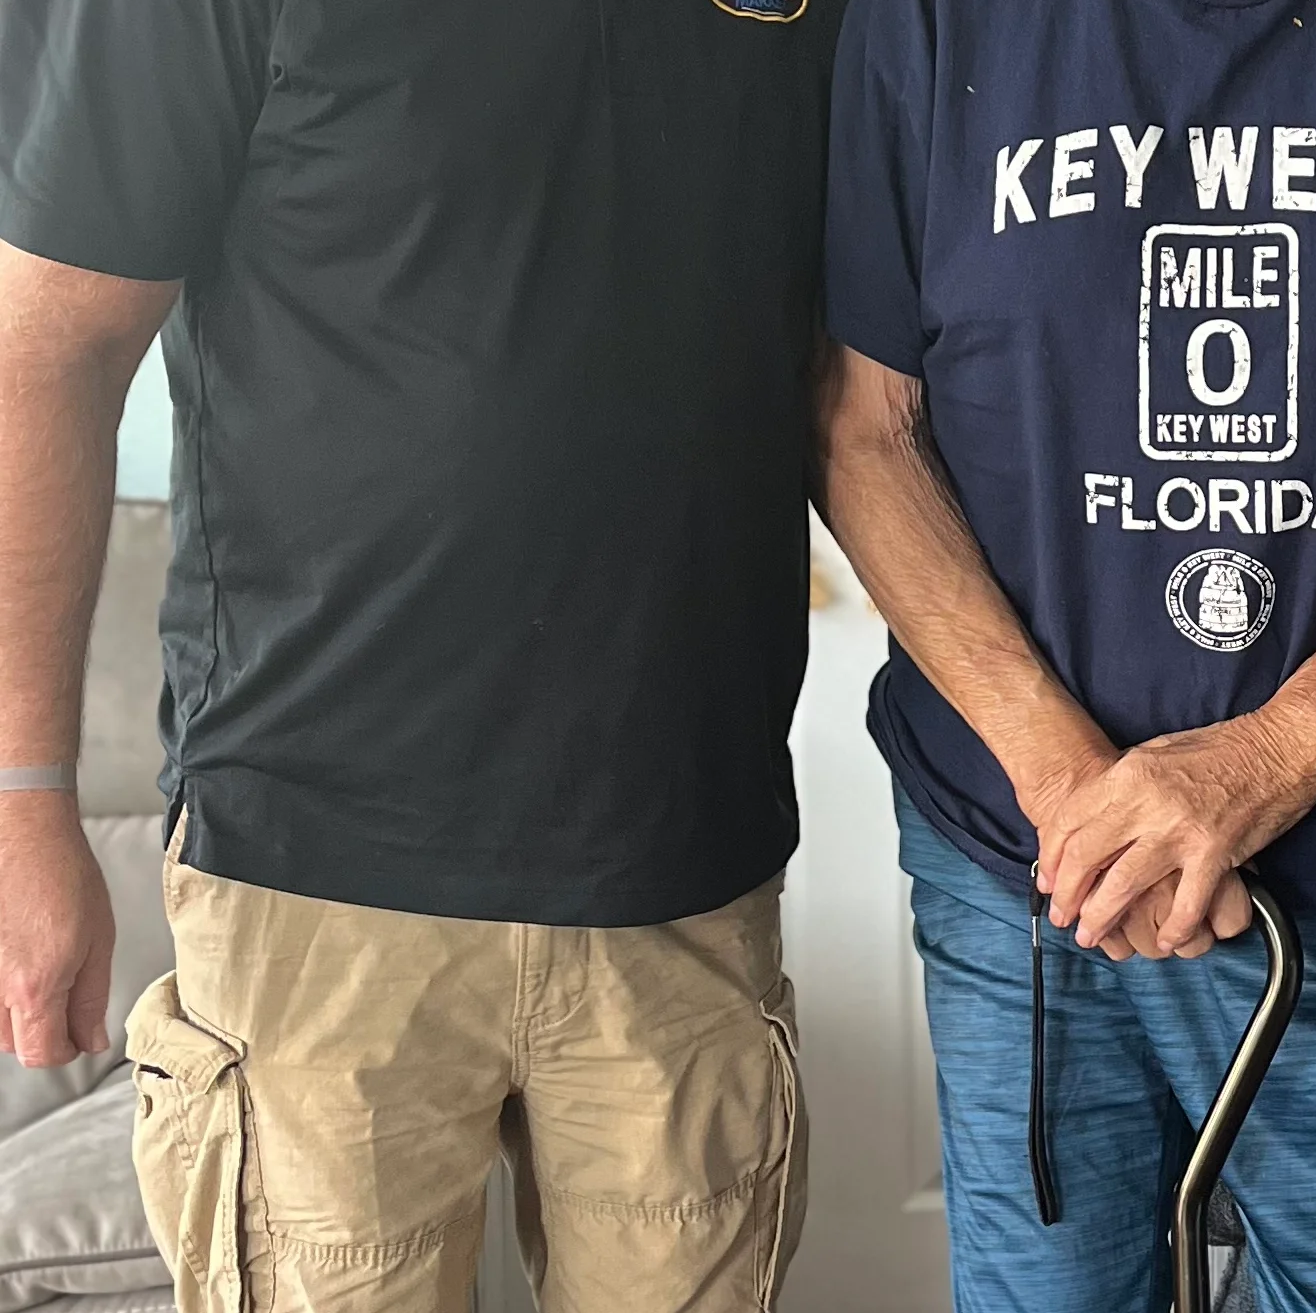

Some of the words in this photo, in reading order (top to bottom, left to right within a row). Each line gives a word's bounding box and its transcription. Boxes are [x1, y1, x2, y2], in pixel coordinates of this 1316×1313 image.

[993, 125, 1164, 234] KEY
[1158, 245, 1281, 309] MILE
[1156, 414, 1205, 444] KEY
[1208, 414, 1277, 444] WEST
